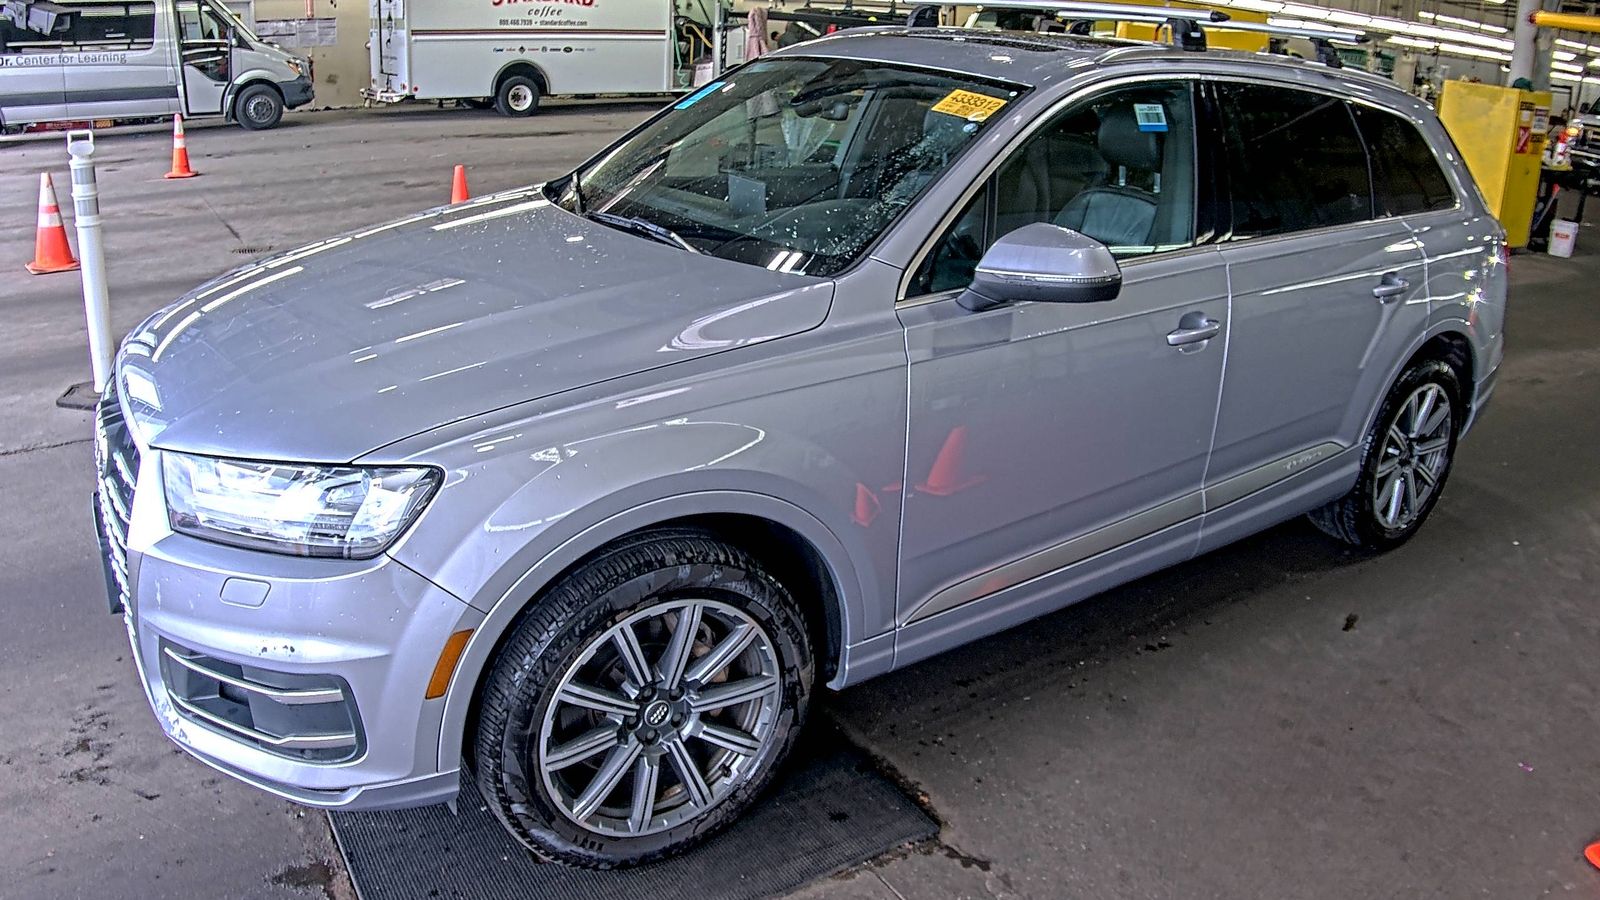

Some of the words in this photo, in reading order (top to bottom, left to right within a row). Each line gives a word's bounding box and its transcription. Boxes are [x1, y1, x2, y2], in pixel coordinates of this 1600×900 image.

[527, 6, 563, 17] coffee
[16, 55, 56, 66] Center
[59, 54, 73, 64] for
[78, 52, 127, 64] Learning
